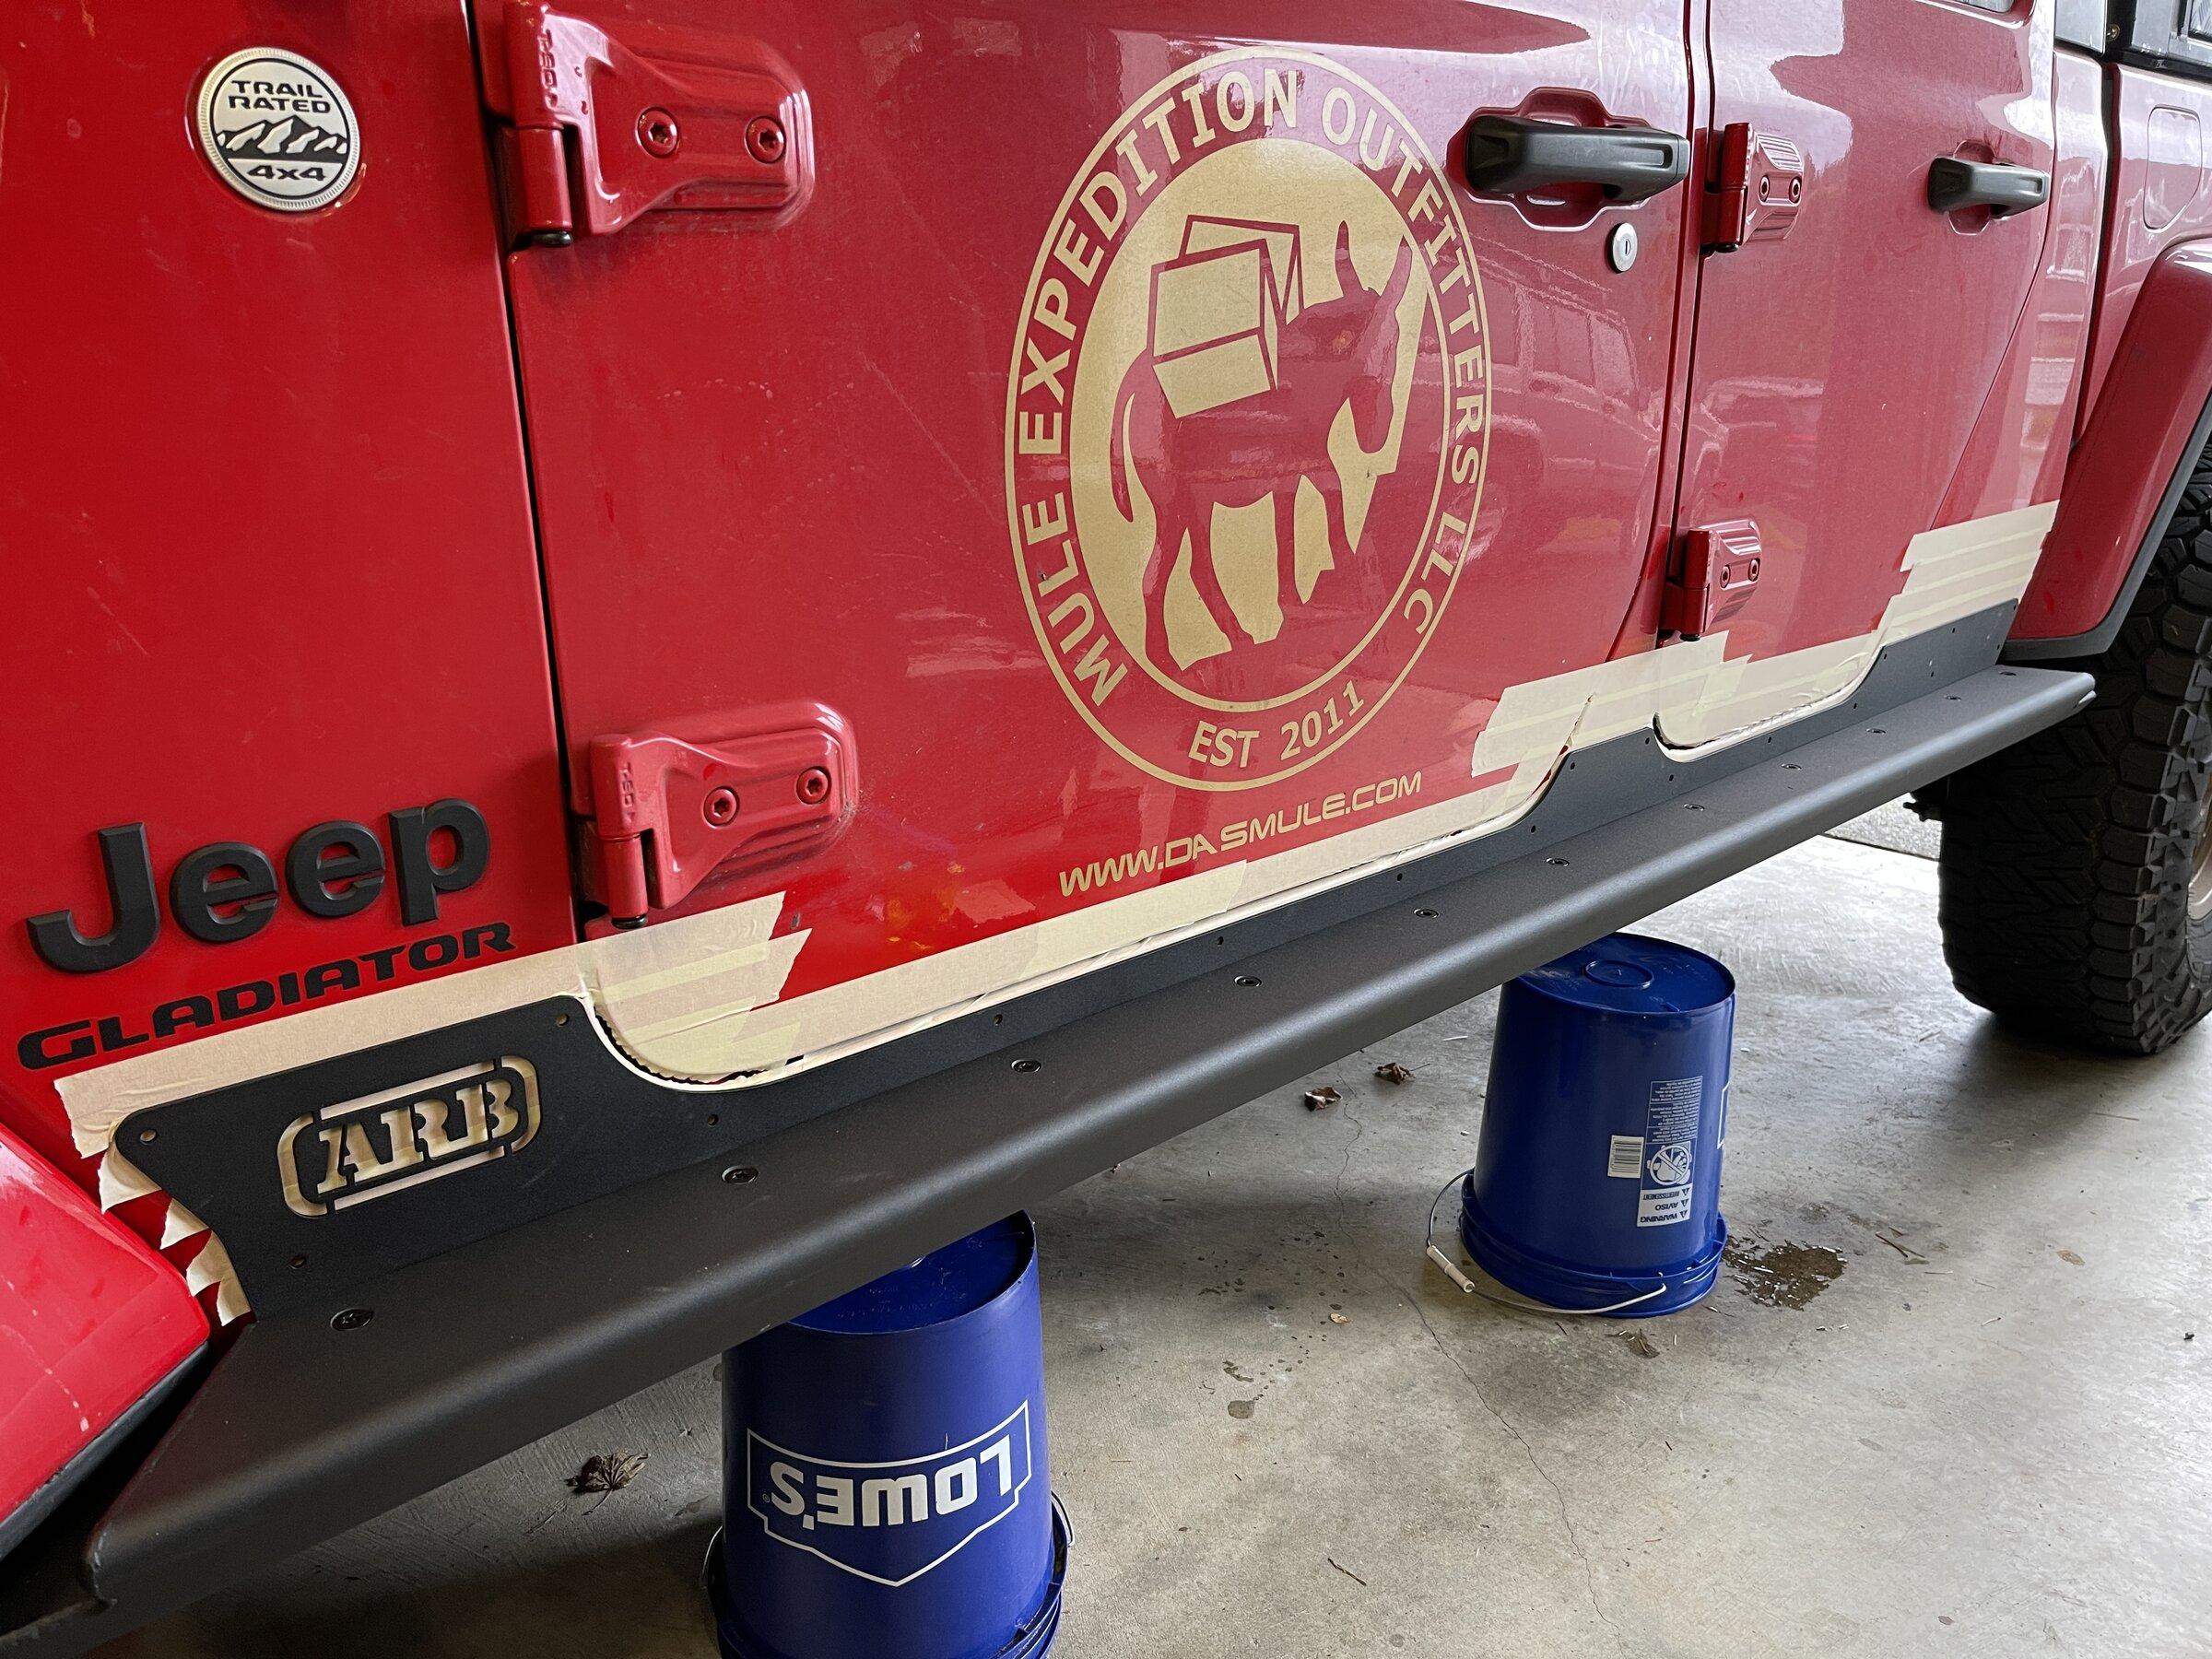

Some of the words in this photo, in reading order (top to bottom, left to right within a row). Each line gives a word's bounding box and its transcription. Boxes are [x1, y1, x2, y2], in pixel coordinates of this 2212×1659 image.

[228, 96, 331, 113] RATED
[231, 80, 323, 99] TRAIL
[247, 164, 326, 182] 4x4
[1019, 68, 1298, 454] EXPEDITION
[1321, 87, 1482, 486] OUTFITTERS
[1022, 491, 1127, 706] MULE
[1403, 511, 1467, 634] LLC
[1188, 720, 1260, 768] EST
[1280, 679, 1364, 760] 2011
[26, 797, 491, 973] Jeep
[17, 922, 517, 1070] GLADIATOR
[316, 1077, 521, 1195] ARB
[1640, 1212, 1678, 1224] WARNING
[1654, 1201, 1679, 1212] AVISO
[770, 1433, 1012, 1531] LOWE'S
